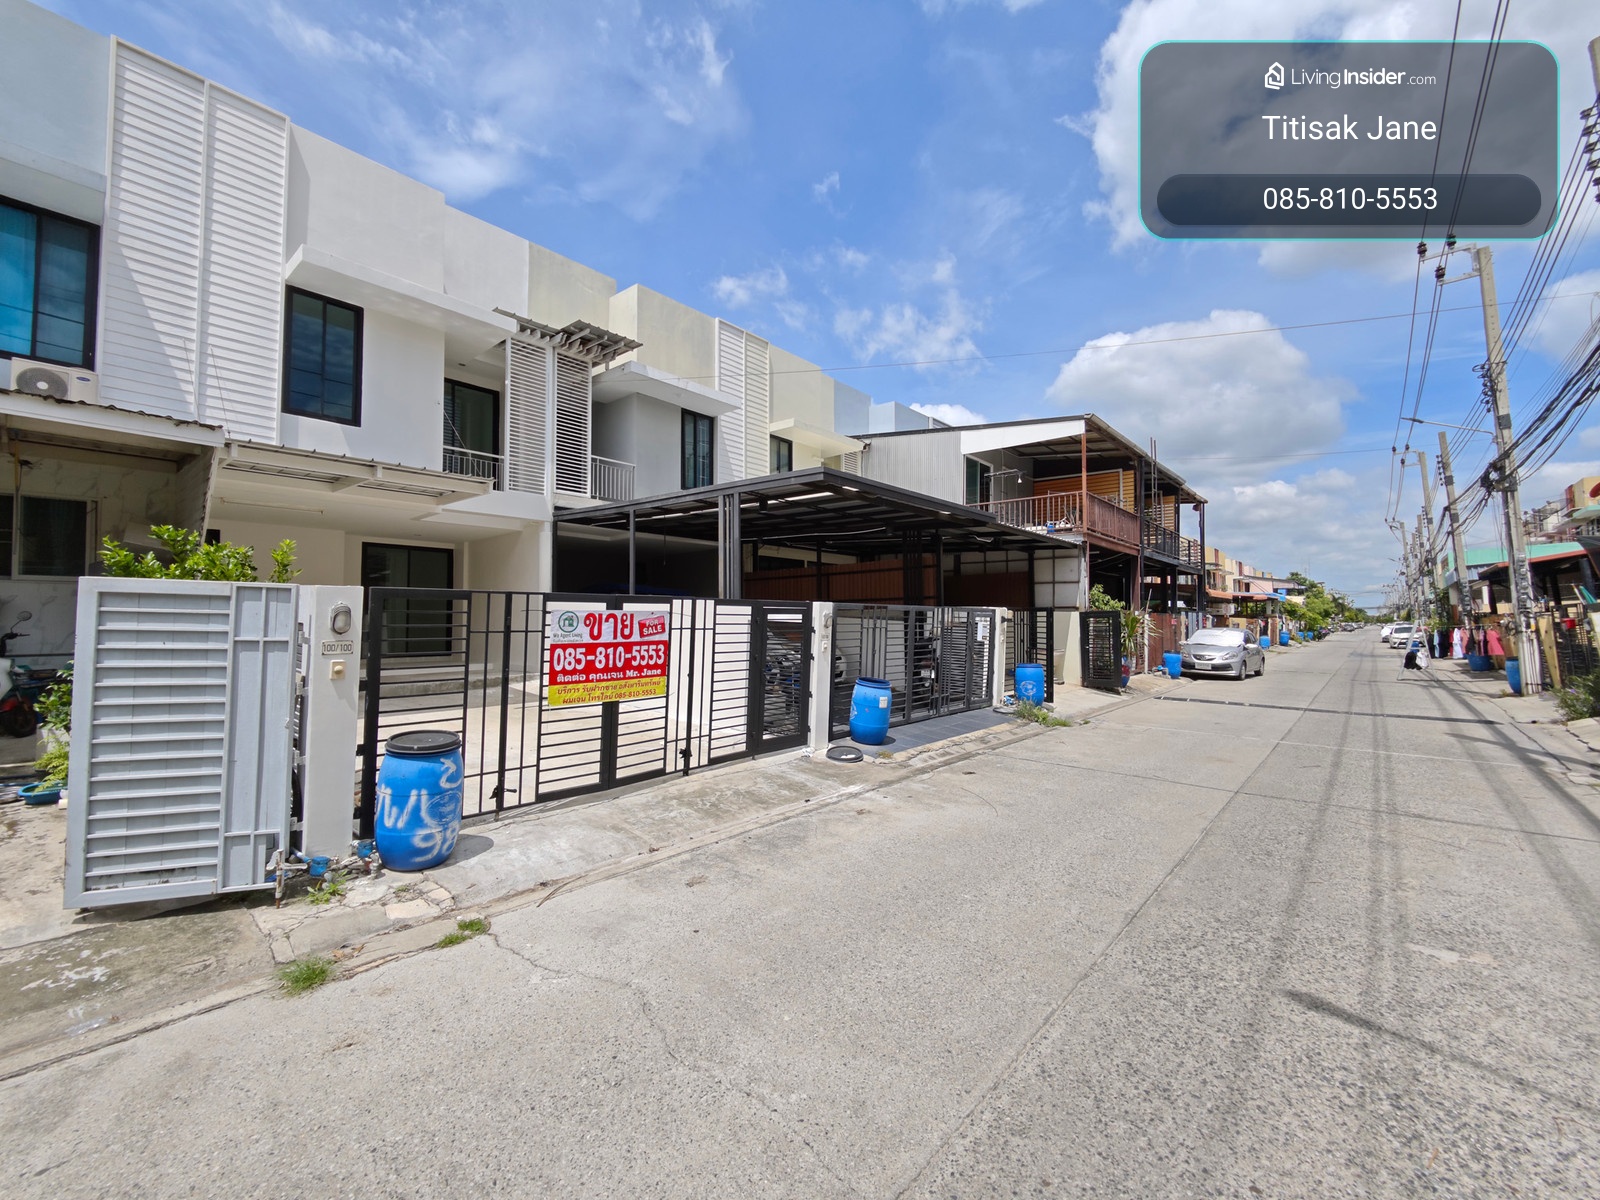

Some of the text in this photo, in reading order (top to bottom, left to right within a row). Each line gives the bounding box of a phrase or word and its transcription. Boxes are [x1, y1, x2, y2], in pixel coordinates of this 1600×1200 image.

[583, 612, 635, 641] ขาย
[645, 619, 659, 627] FOR
[643, 625, 662, 636] SALE
[323, 643, 352, 652] 100/100
[553, 644, 665, 671] 085-810-5553
[557, 668, 662, 683] ติดต่อ คุณเจน Mr. Jane
[557, 685, 580, 695] บริการ
[614, 688, 657, 700] 085-810-5553
